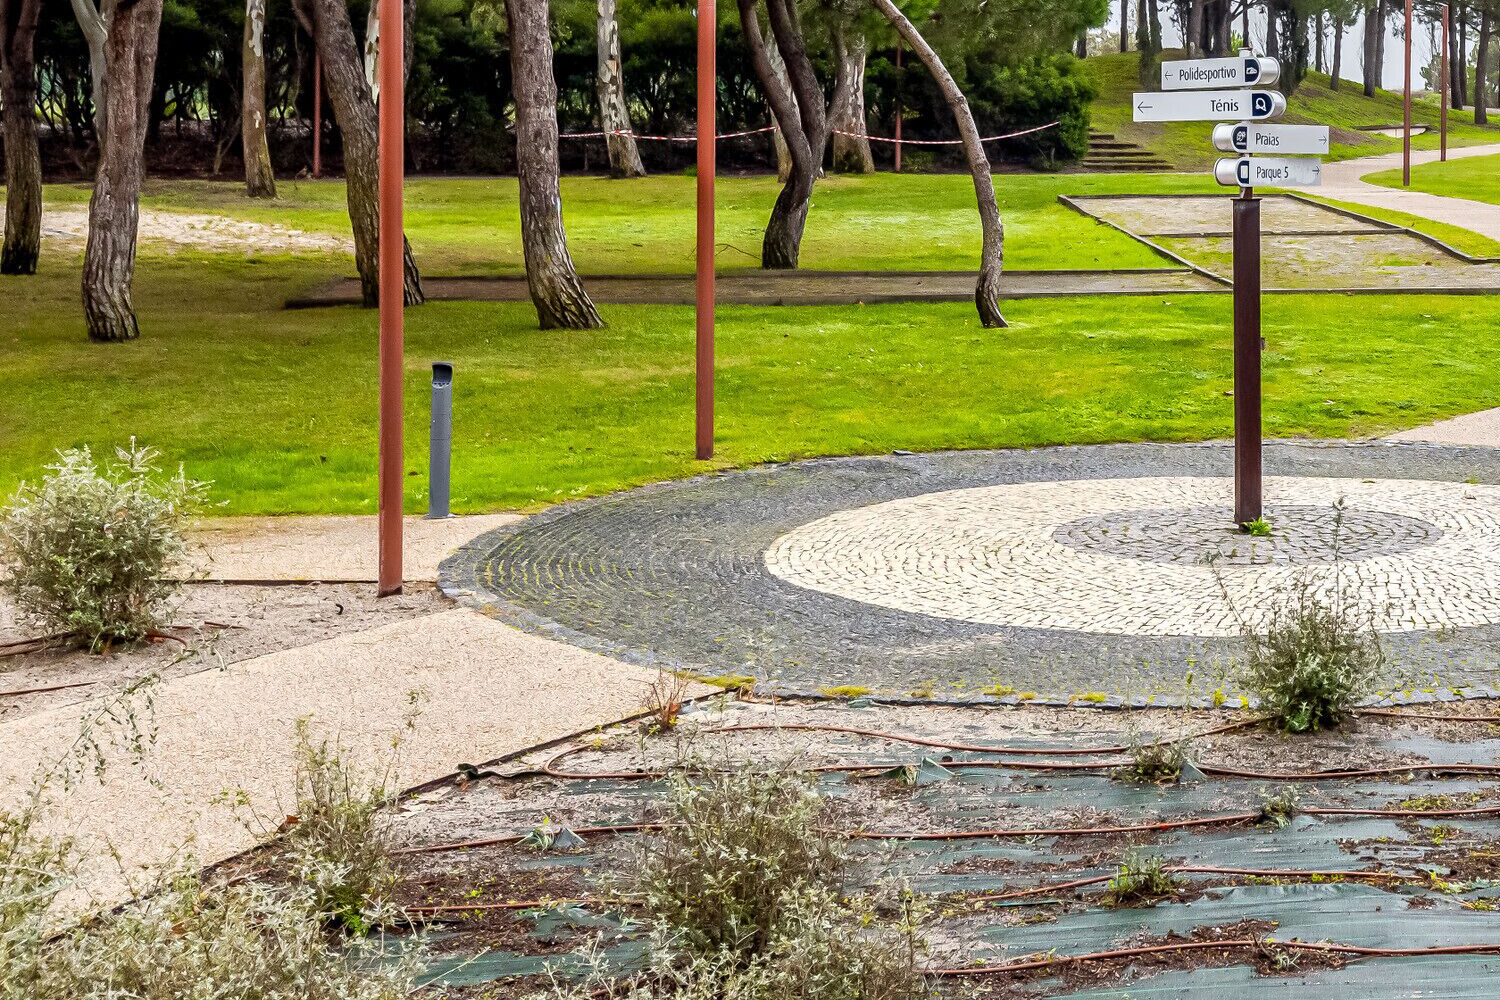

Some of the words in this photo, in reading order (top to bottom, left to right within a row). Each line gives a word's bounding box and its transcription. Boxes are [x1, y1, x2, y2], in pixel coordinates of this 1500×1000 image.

[1179, 66, 1237, 82] Polidesportivo
[1210, 99, 1239, 112] Ténis
[1255, 132, 1280, 146] Praias
[1256, 166, 1281, 181] Parque
[1284, 166, 1289, 178] 5
